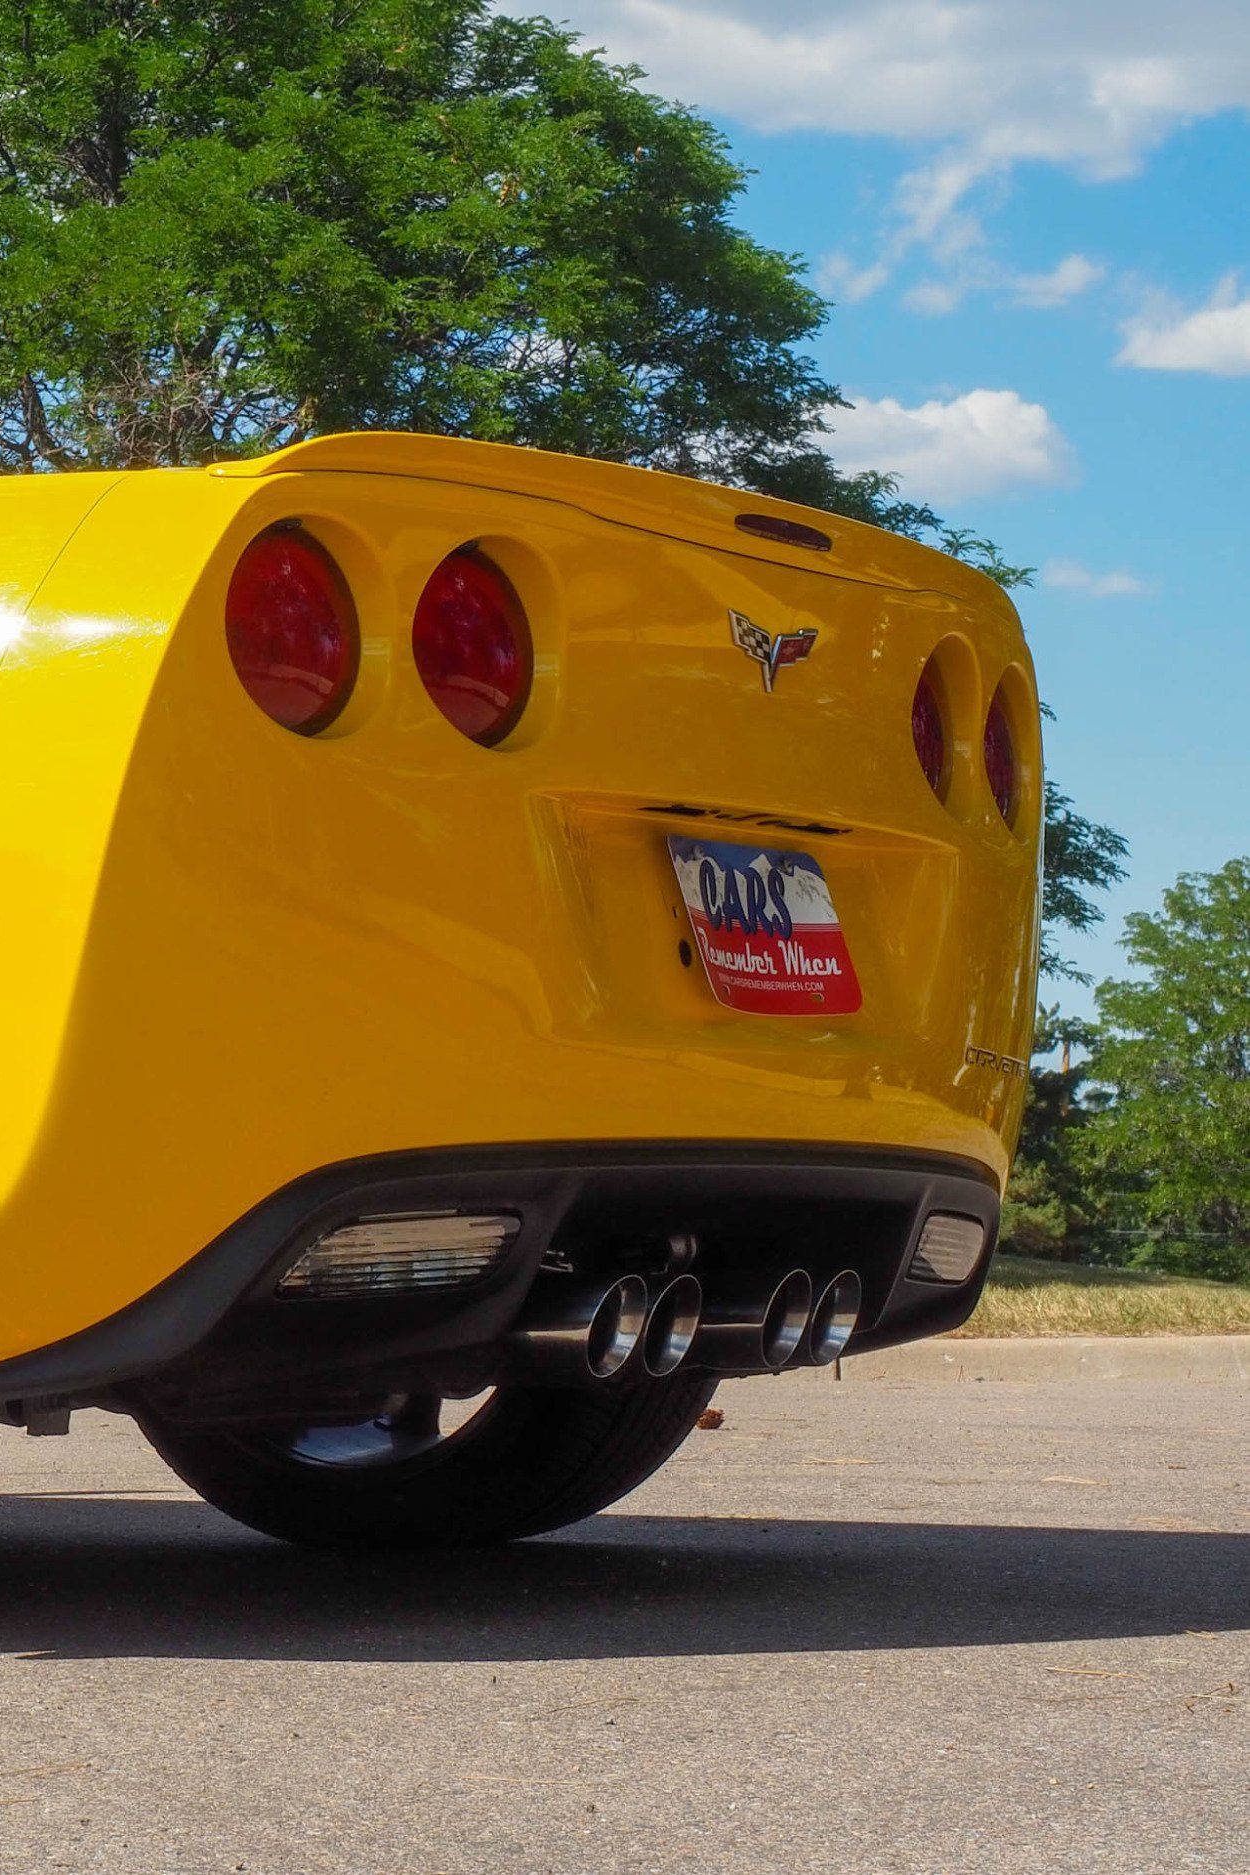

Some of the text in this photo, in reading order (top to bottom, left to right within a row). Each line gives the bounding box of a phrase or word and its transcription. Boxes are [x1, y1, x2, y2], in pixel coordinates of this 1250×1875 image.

[699, 858, 793, 940] CARS
[697, 926, 842, 976] Remember When
[718, 973, 825, 992] CARSREMEMBERWHEN.COM
